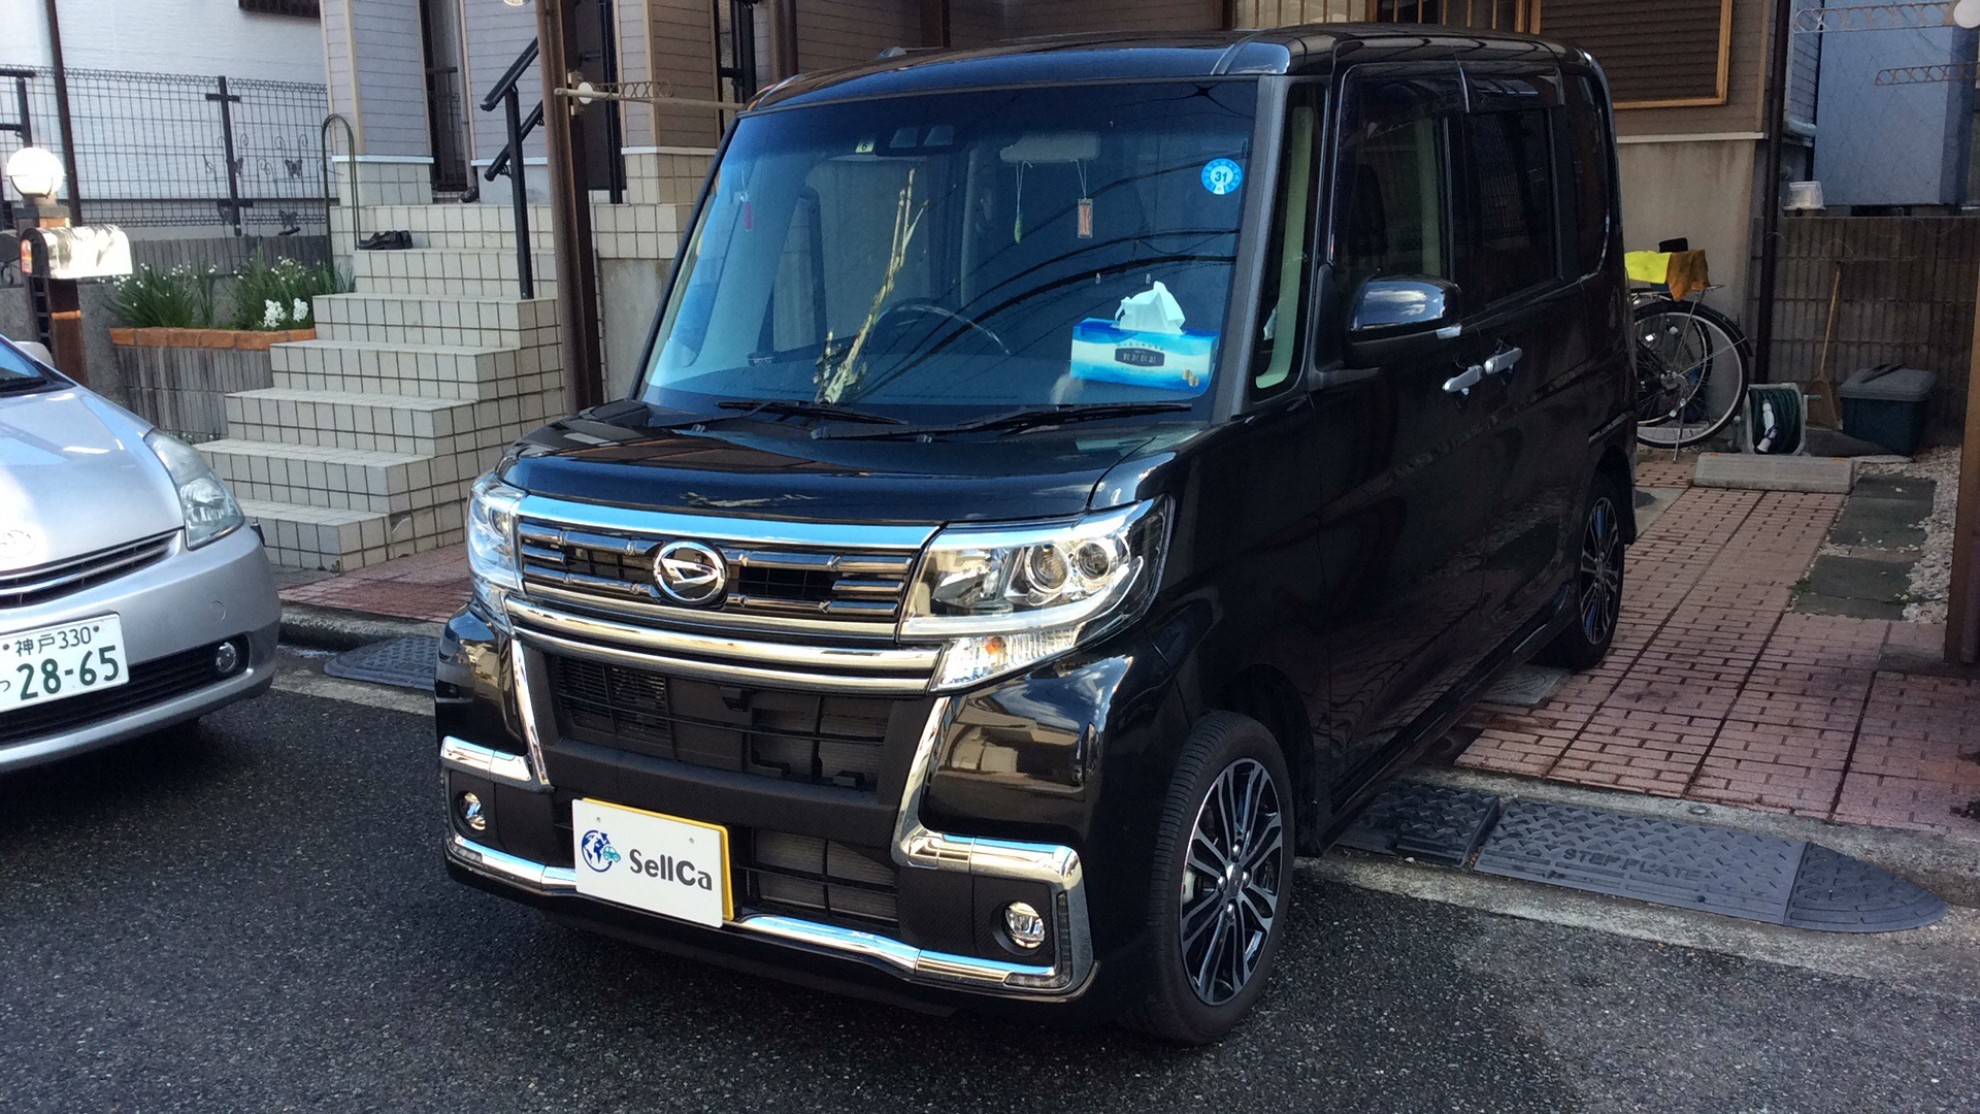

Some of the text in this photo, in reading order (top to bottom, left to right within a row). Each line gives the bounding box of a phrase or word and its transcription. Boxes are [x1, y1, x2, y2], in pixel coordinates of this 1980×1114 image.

[1214, 171, 1228, 183] 31
[14, 626, 92, 657] 神戸330
[16, 645, 119, 700] 28-65
[629, 848, 713, 891] SellCa
[1562, 848, 1702, 881] STEP PLATE
